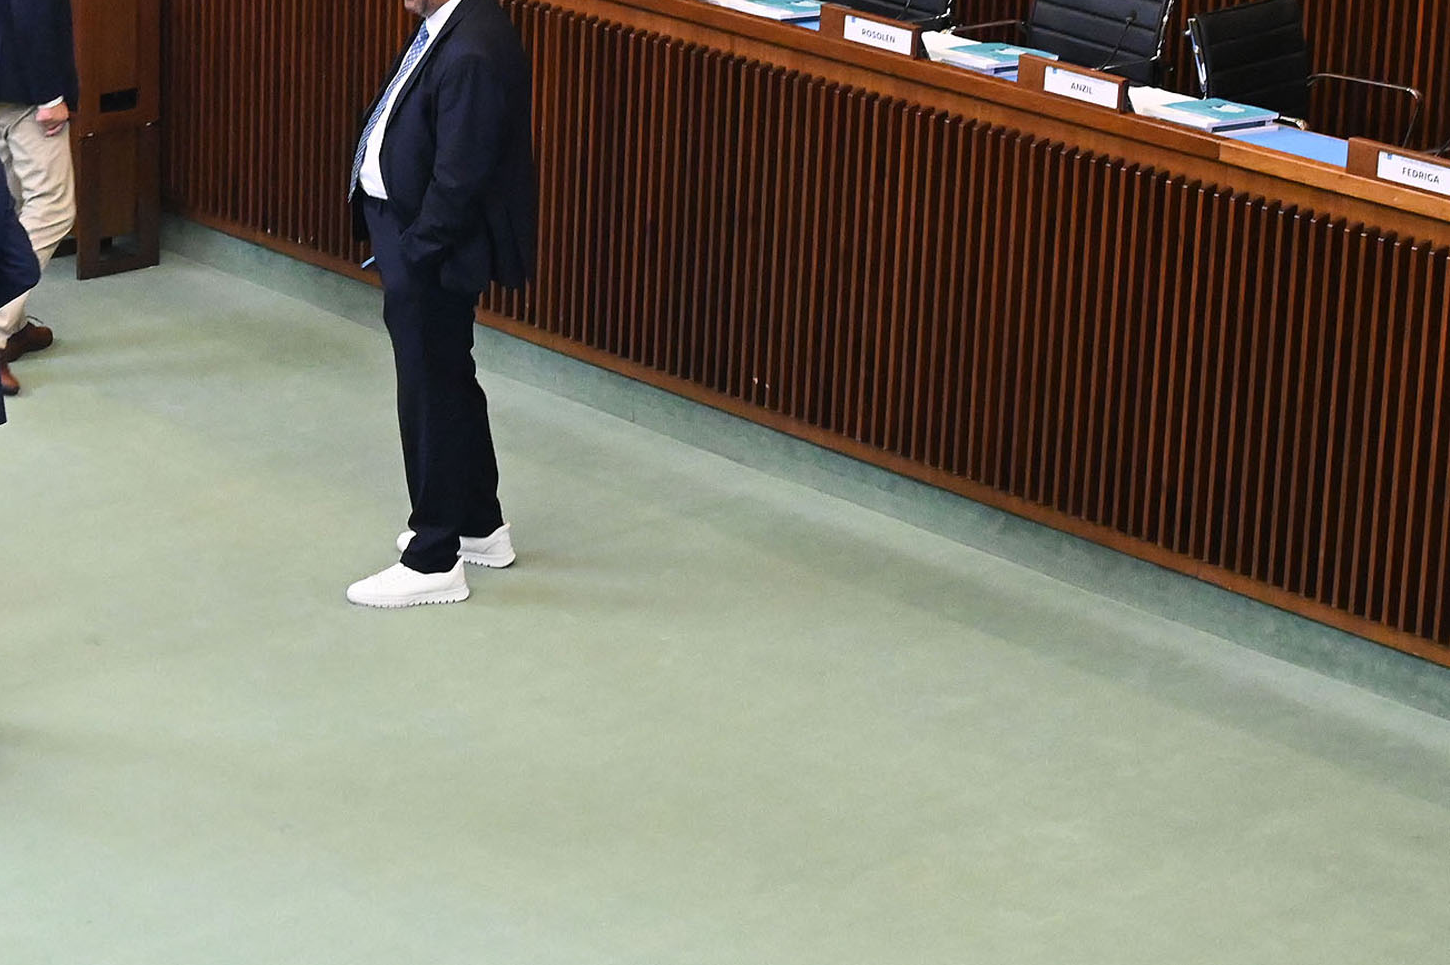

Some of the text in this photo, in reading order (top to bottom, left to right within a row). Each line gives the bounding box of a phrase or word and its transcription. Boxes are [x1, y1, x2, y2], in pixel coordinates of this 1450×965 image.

[861, 28, 896, 44] ROSOLEN
[1070, 82, 1093, 95] ANZIL
[1402, 166, 1440, 184] FEDRIGA
